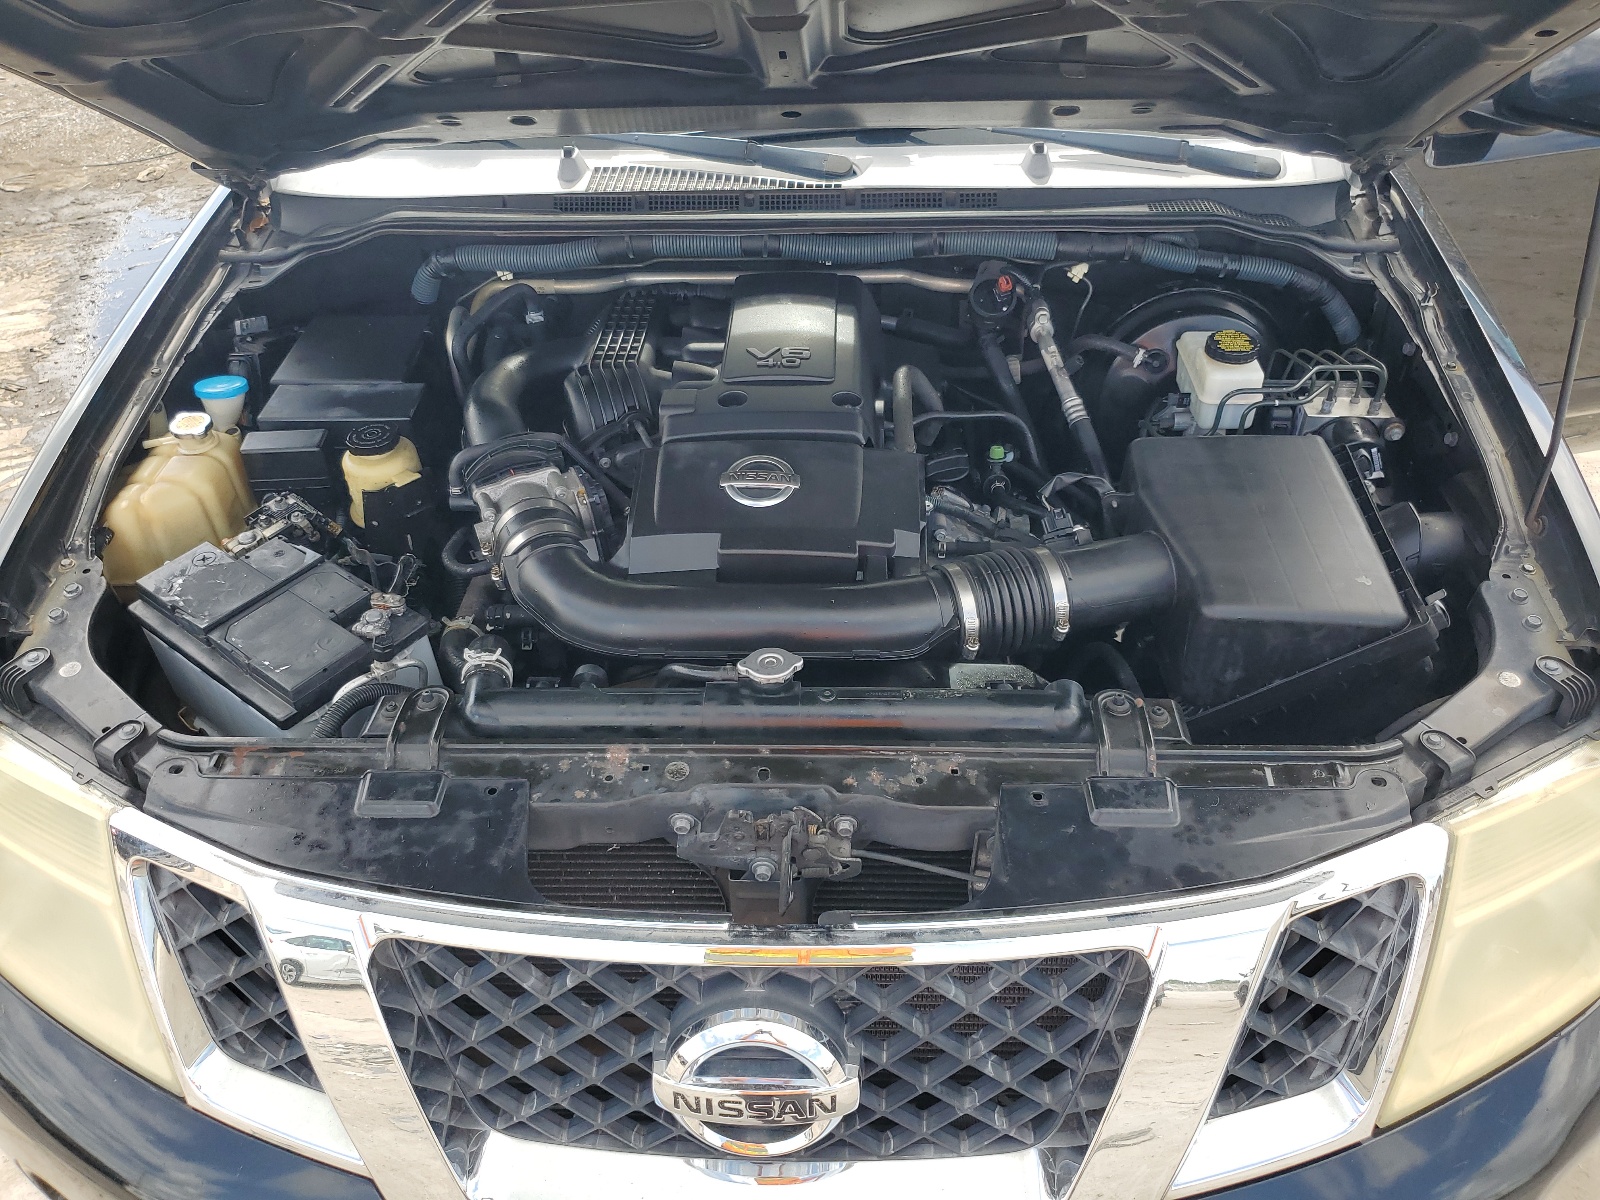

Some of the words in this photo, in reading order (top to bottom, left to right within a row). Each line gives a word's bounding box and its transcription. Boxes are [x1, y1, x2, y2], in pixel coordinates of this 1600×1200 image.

[746, 346, 811, 360] V6
[756, 357, 801, 368] 4.0
[729, 472, 792, 482] NISSAN
[672, 1091, 837, 1121] NISSAN
